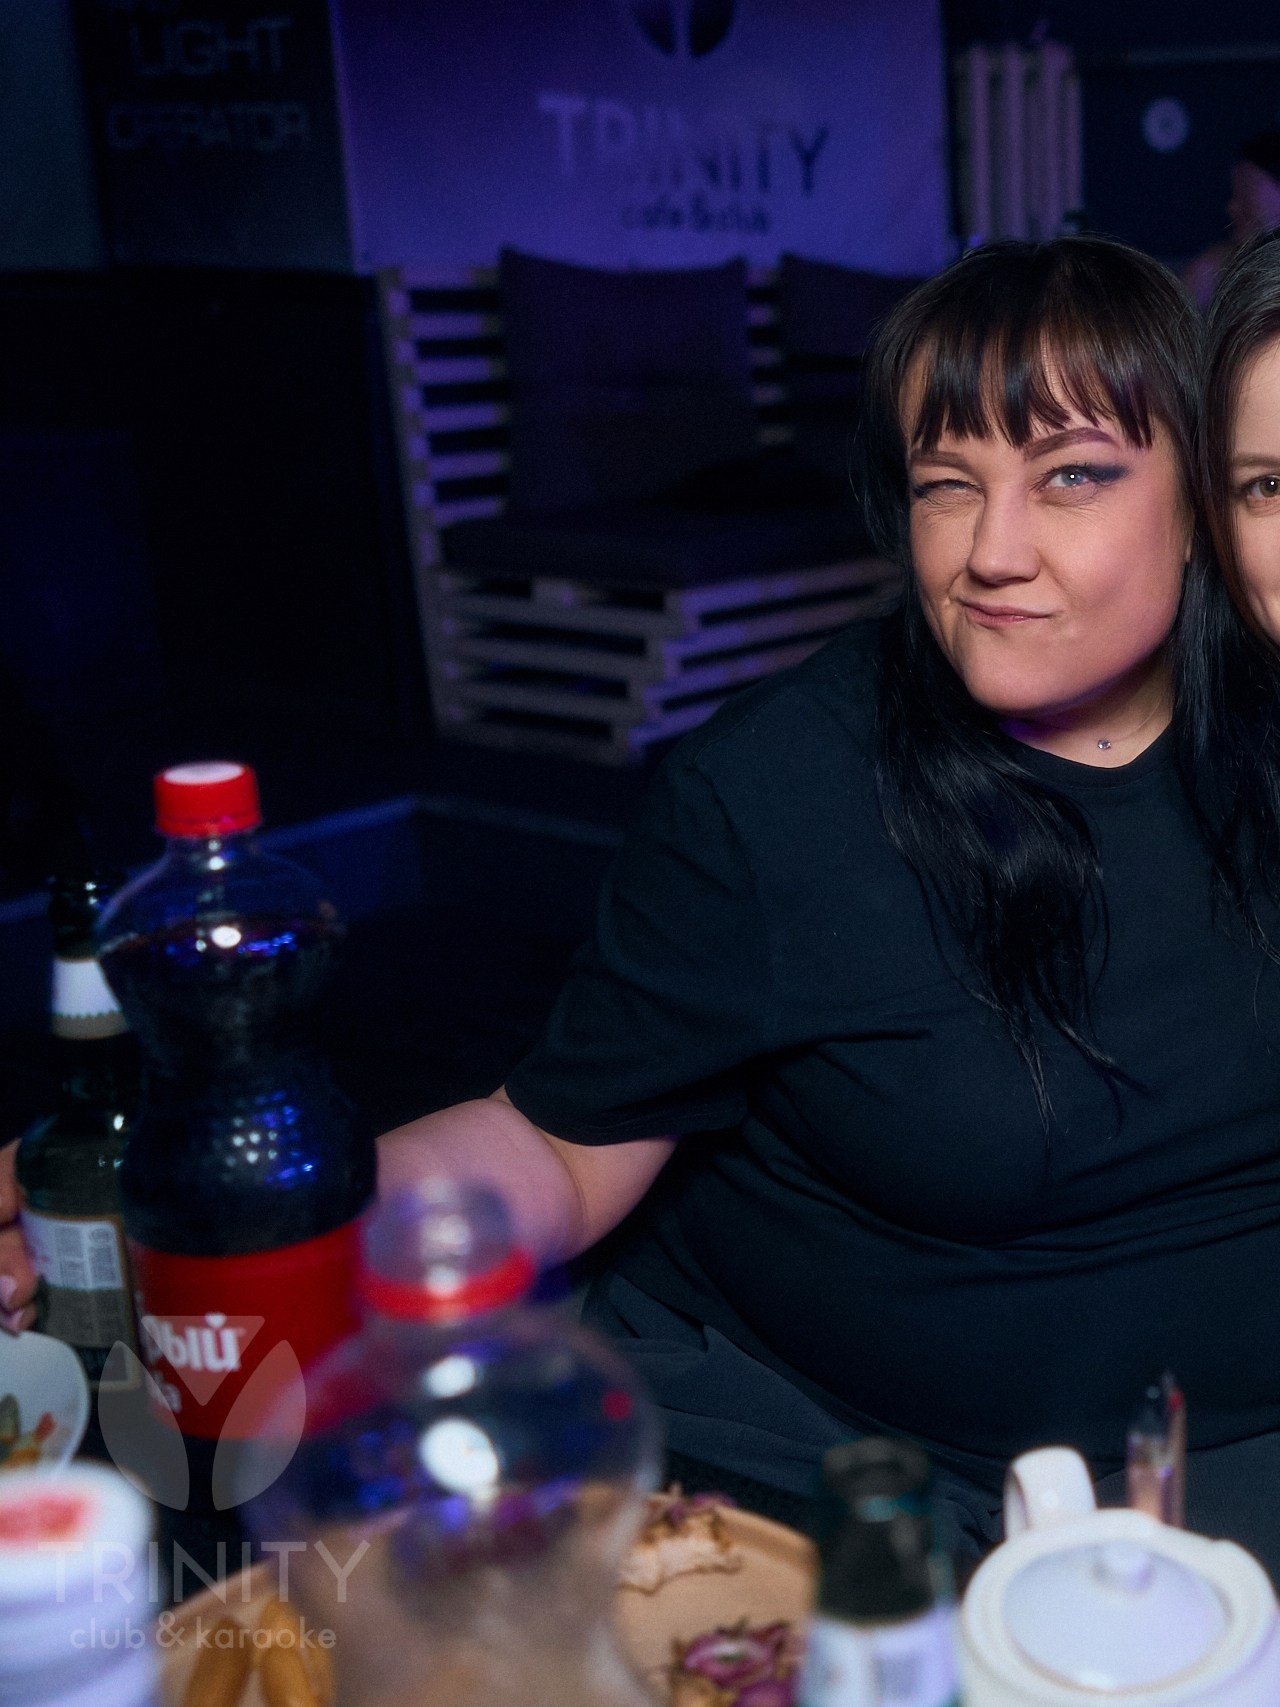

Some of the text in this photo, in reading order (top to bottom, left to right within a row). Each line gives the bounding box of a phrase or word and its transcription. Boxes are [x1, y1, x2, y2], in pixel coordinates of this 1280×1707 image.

[127, 14, 294, 77] LIGHT
[106, 100, 311, 153] OPERATOR
[537, 91, 829, 197] TRINITY
